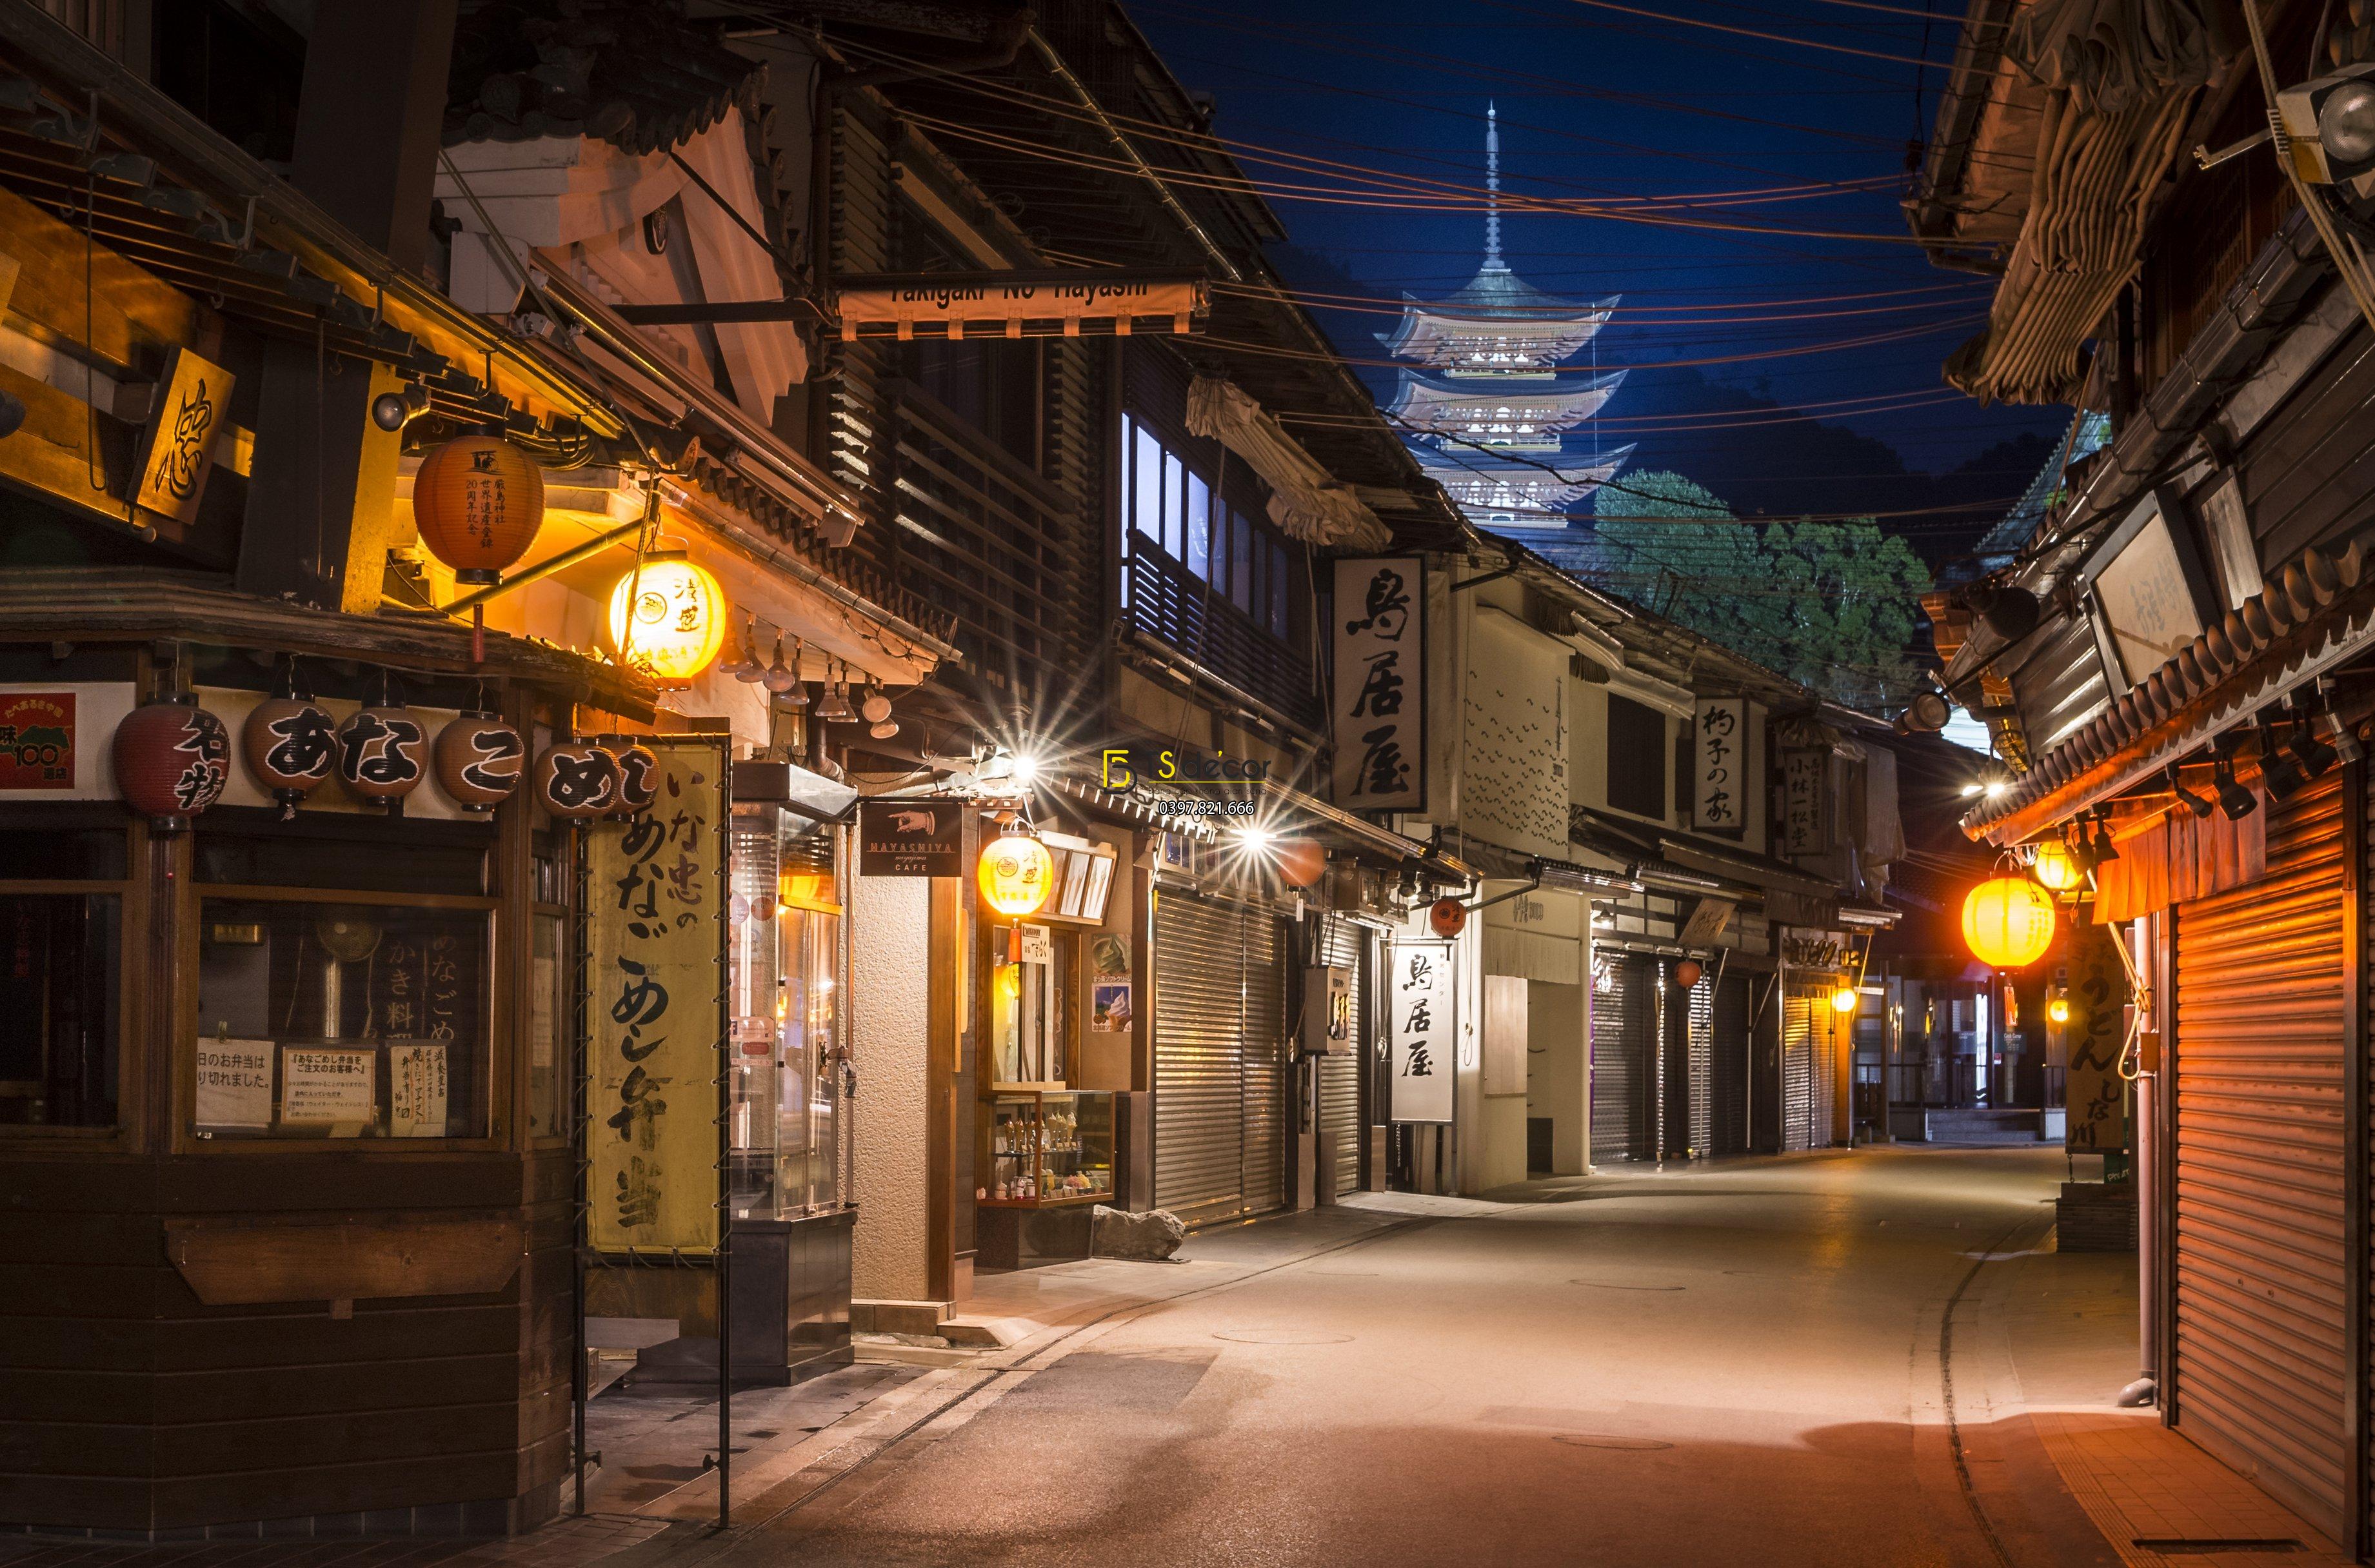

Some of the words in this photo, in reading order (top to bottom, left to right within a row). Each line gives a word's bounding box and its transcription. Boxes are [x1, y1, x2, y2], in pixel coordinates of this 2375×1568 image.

[14, 743, 59, 768] 100
[174, 711, 230, 811] 名物
[1703, 706, 1735, 822] 杓子の家
[667, 771, 706, 929] いな忠の
[871, 842, 952, 853] HAYASHIYA
[895, 854, 926, 863] miyajima
[198, 1052, 265, 1069] 日のお弁当は
[198, 1071, 269, 1089] り切れました。
